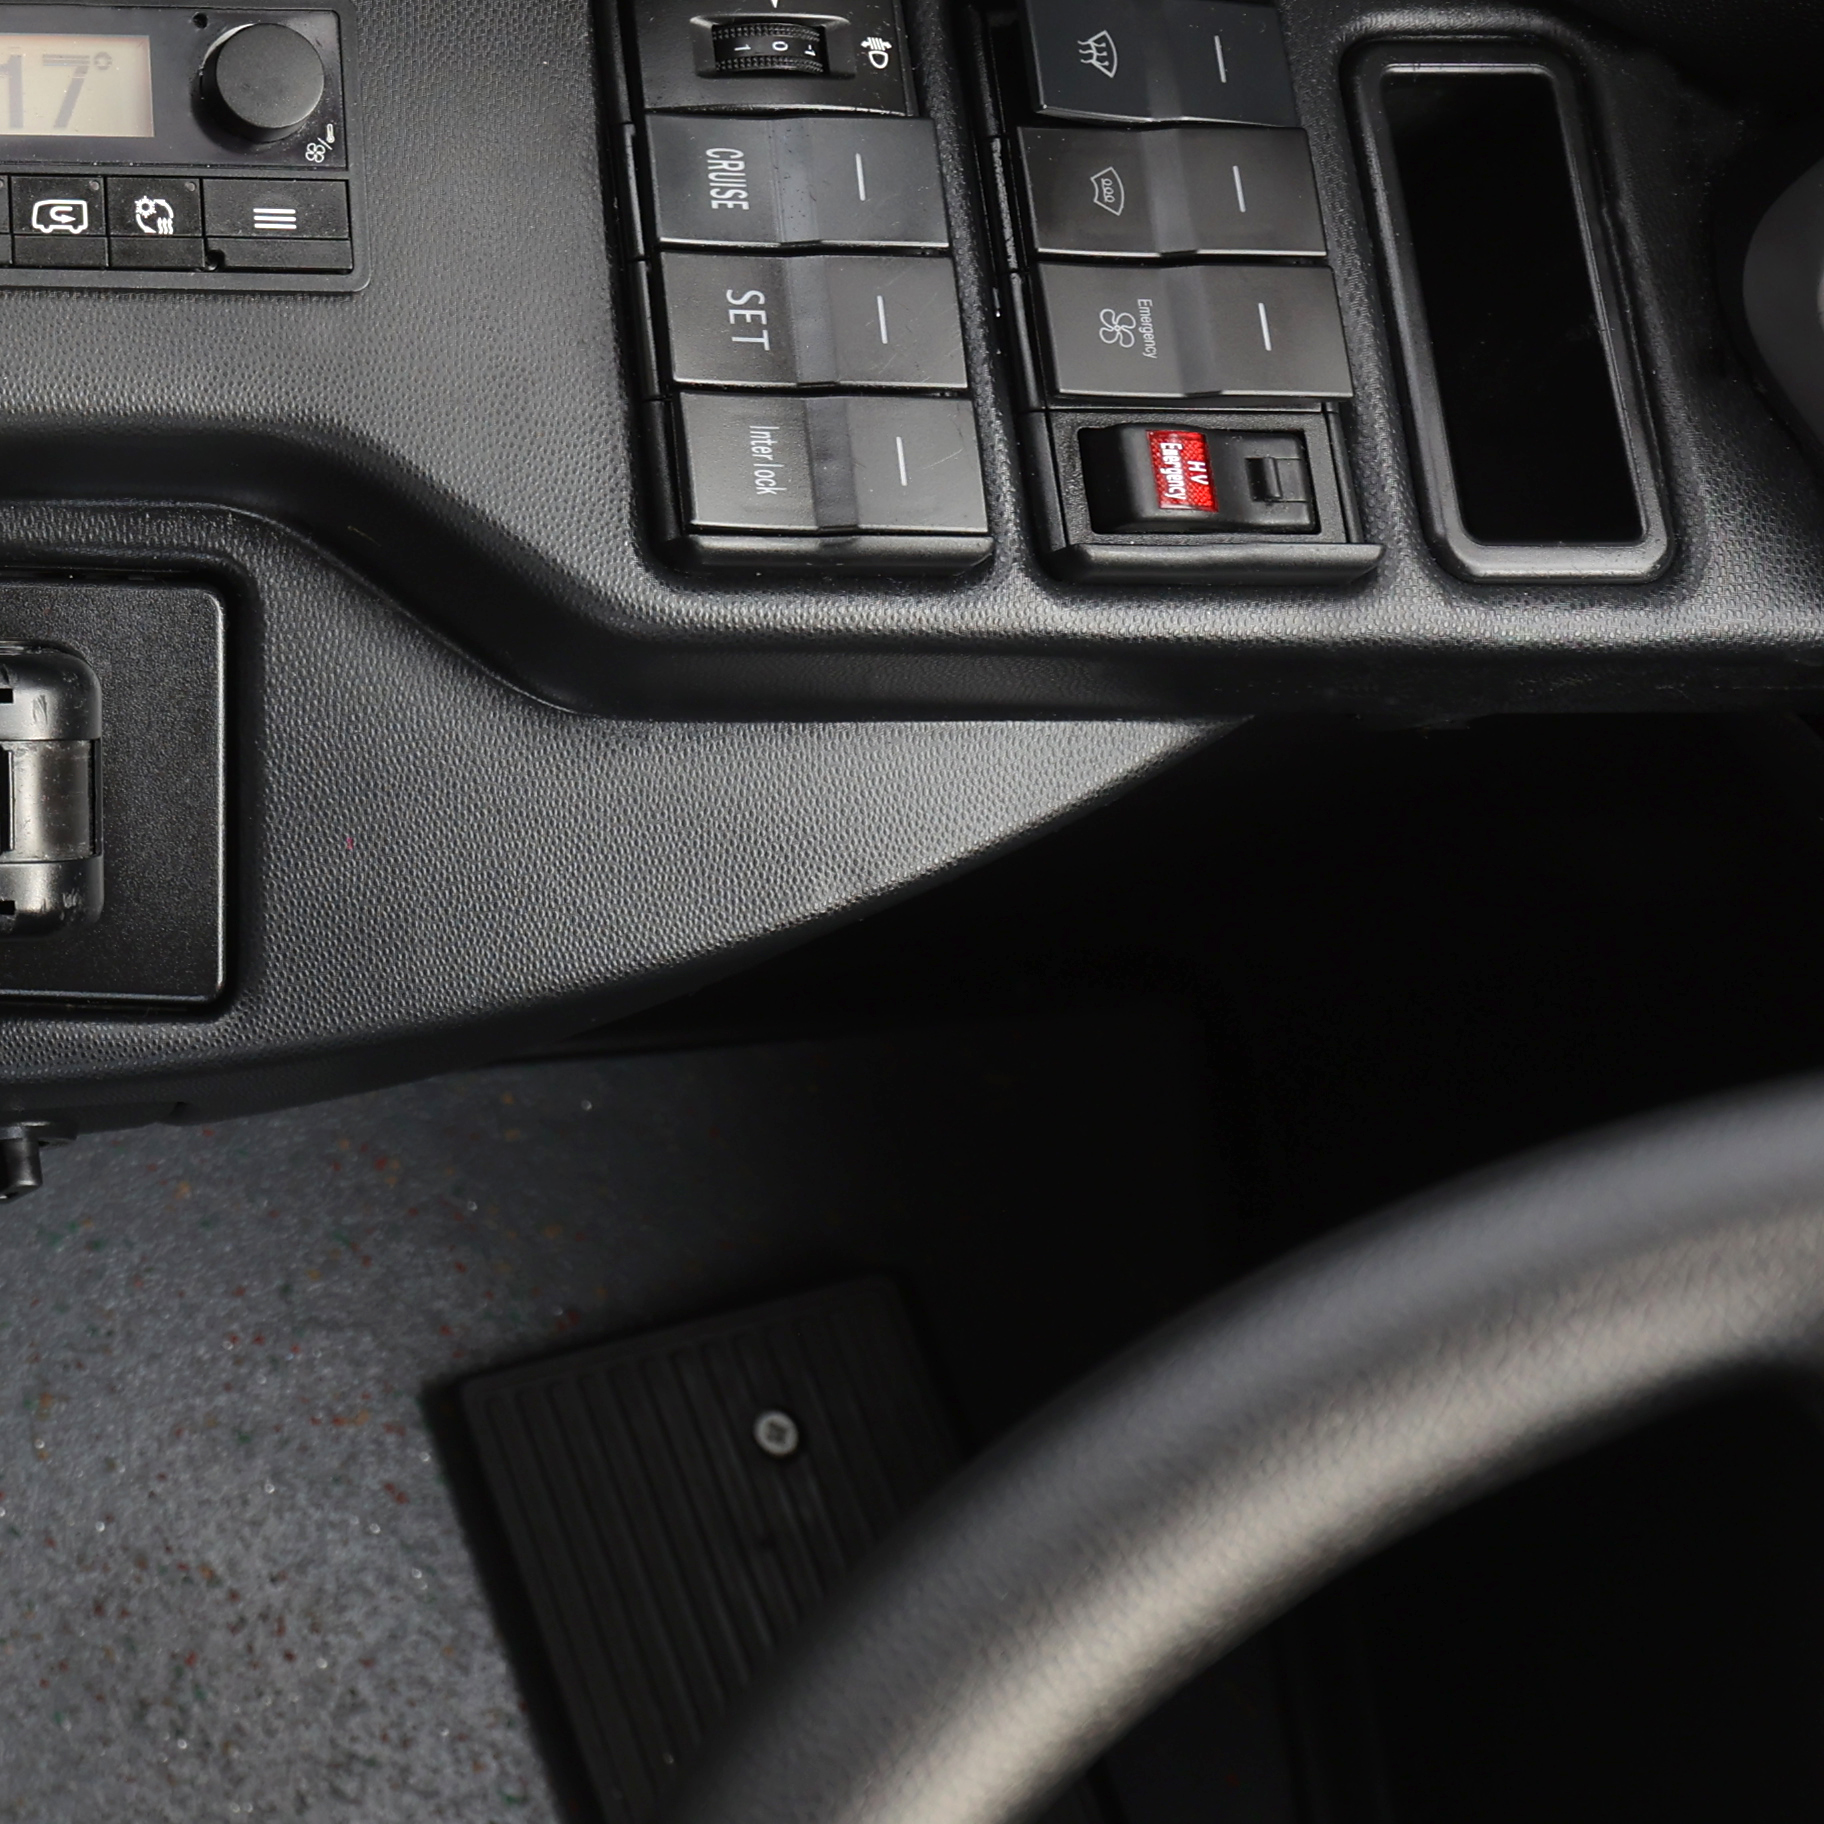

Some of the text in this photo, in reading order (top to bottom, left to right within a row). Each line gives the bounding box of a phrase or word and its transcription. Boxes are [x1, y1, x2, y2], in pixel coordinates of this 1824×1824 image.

[734, 43, 751, 52] 1
[772, 40, 789, 52] 0
[705, 147, 750, 210] CRUISE
[725, 289, 770, 351] SET
[1137, 298, 1158, 360] Emergency
[1160, 442, 1187, 501] Emergency
